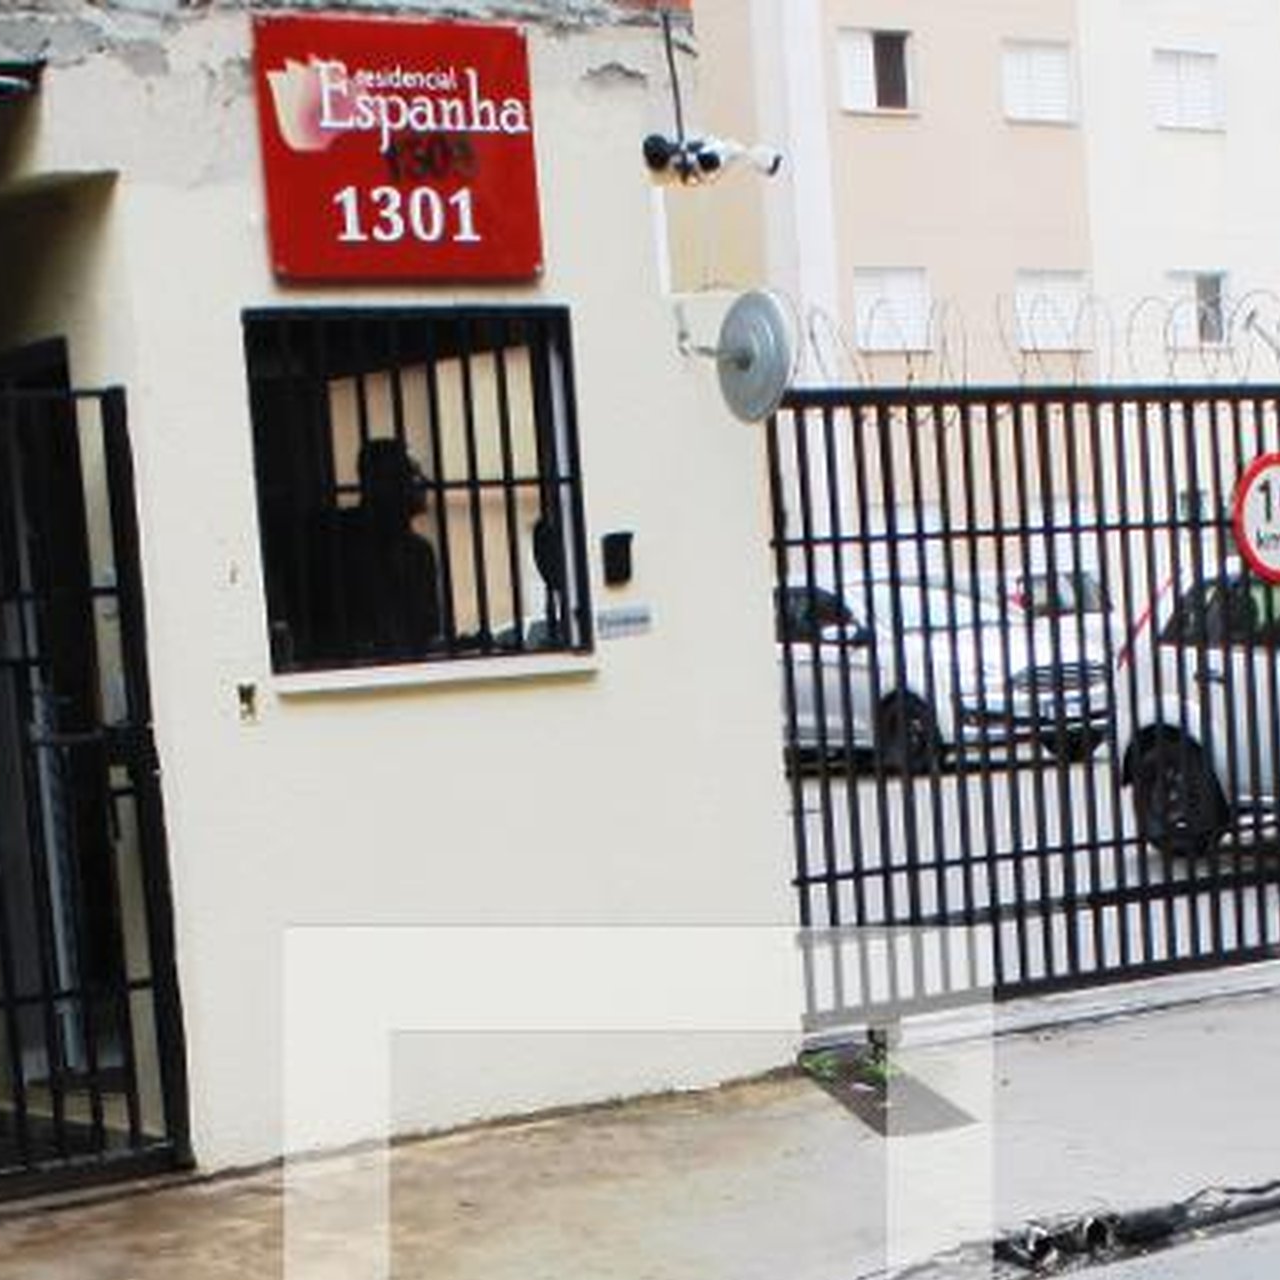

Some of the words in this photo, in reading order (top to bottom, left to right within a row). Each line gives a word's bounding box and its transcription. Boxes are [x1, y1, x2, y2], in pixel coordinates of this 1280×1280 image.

[354, 64, 458, 90] residencial
[317, 59, 529, 153] Espanha
[332, 186, 482, 242] 1301
